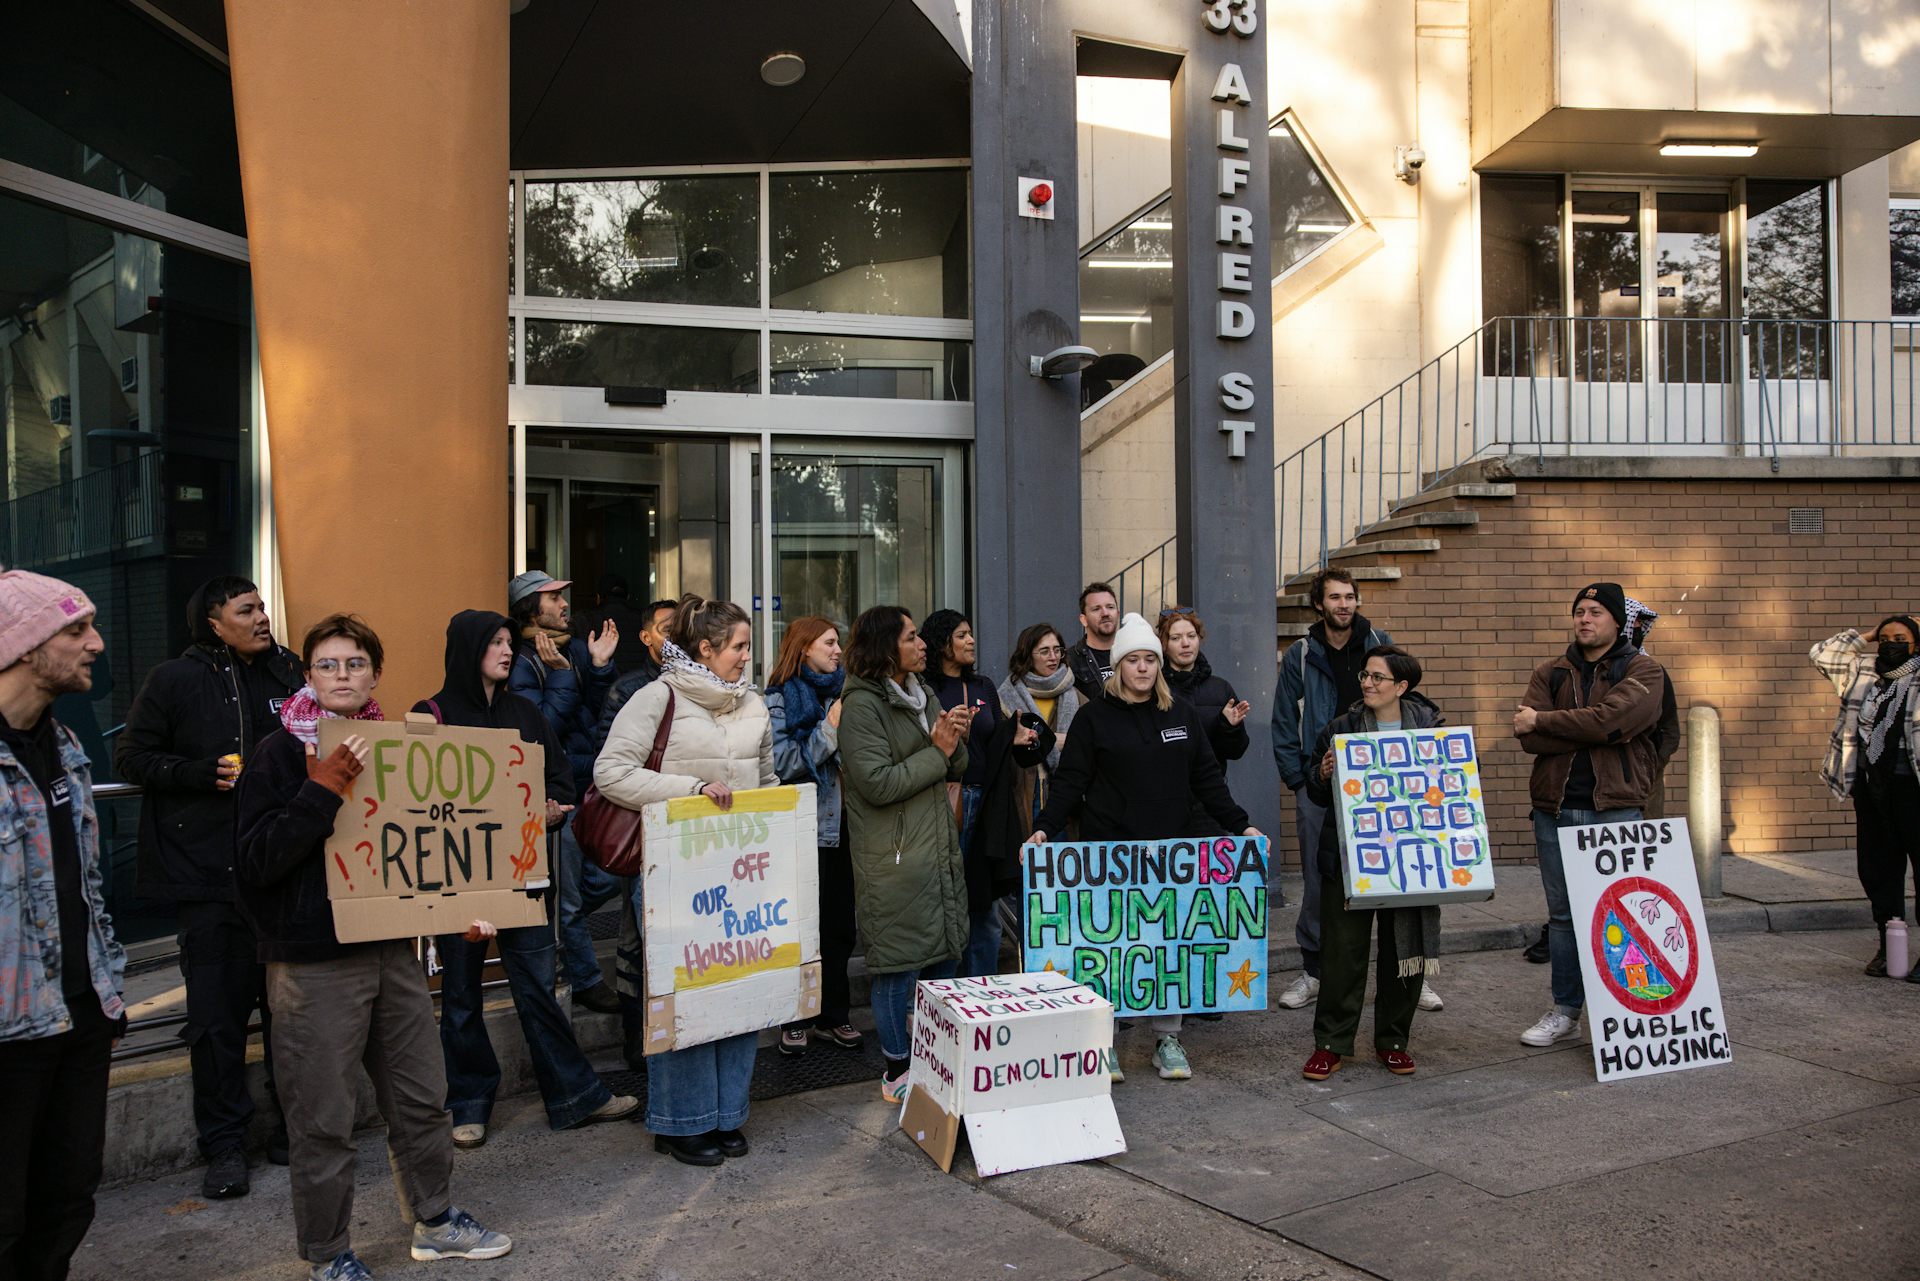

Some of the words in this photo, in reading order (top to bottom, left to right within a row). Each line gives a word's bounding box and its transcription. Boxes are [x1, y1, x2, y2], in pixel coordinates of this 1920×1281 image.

[1202, 0, 1257, 36] 33
[1212, 63, 1255, 339] ALFRED
[1218, 372, 1255, 457] ST
[375, 740, 495, 804] FOOD
[1354, 741, 1464, 765] SAVE
[1370, 775, 1460, 797] OUR
[679, 812, 773, 859] HANDS
[1359, 808, 1468, 830] HOME
[1577, 822, 1672, 850] HANDS
[381, 822, 502, 891] RENT
[732, 852, 769, 882] OFF
[1028, 842, 1195, 888] HOUSING
[1199, 837, 1236, 884] IS
[1233, 840, 1267, 886] A
[1595, 846, 1657, 875] OFF
[692, 885, 732, 915] OUR
[723, 898, 788, 938] PUBLIC
[1028, 887, 1267, 948] HUMAN
[684, 937, 776, 980] HOUSING
[1073, 943, 1229, 1011] RIGHT
[928, 975, 1010, 991] SAVE
[943, 983, 1061, 1003] PUBLIC
[917, 985, 959, 1046] RENOVATE
[960, 994, 1096, 1018] HOUSING
[1603, 1007, 1714, 1041] PUBLIC
[918, 1019, 936, 1047] NOT
[974, 1025, 1010, 1051] NO
[914, 1037, 953, 1088] DEMOLISH
[973, 1047, 1114, 1092] DEMOLITION
[1600, 1033, 1730, 1074] HOUSING!
